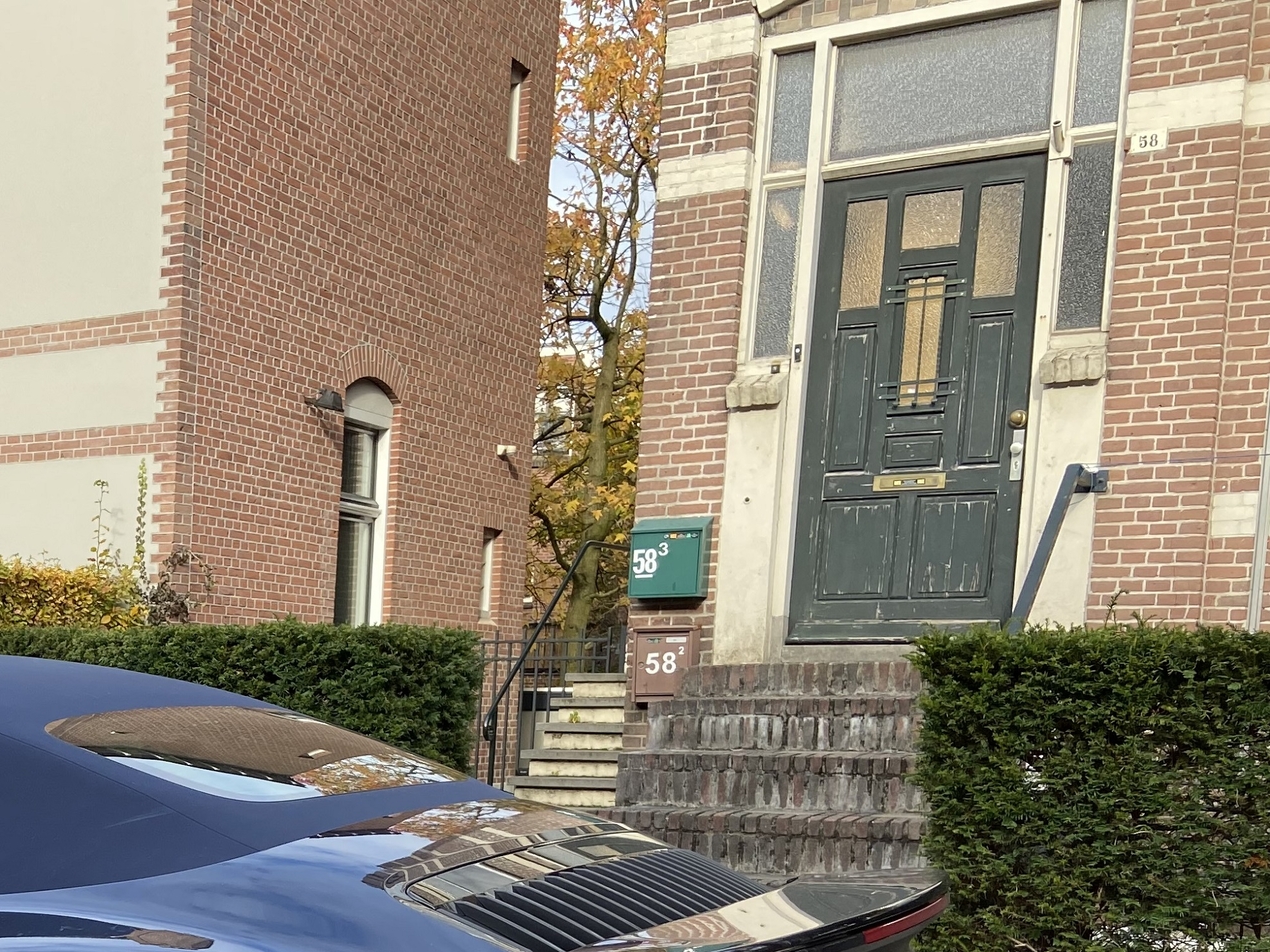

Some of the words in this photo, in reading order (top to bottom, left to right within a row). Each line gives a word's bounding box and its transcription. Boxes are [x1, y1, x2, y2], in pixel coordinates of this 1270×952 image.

[1138, 133, 1159, 149] 58
[632, 548, 658, 575] 58
[658, 542, 669, 556] 3
[644, 652, 677, 675] 58
[678, 646, 685, 655] 2
